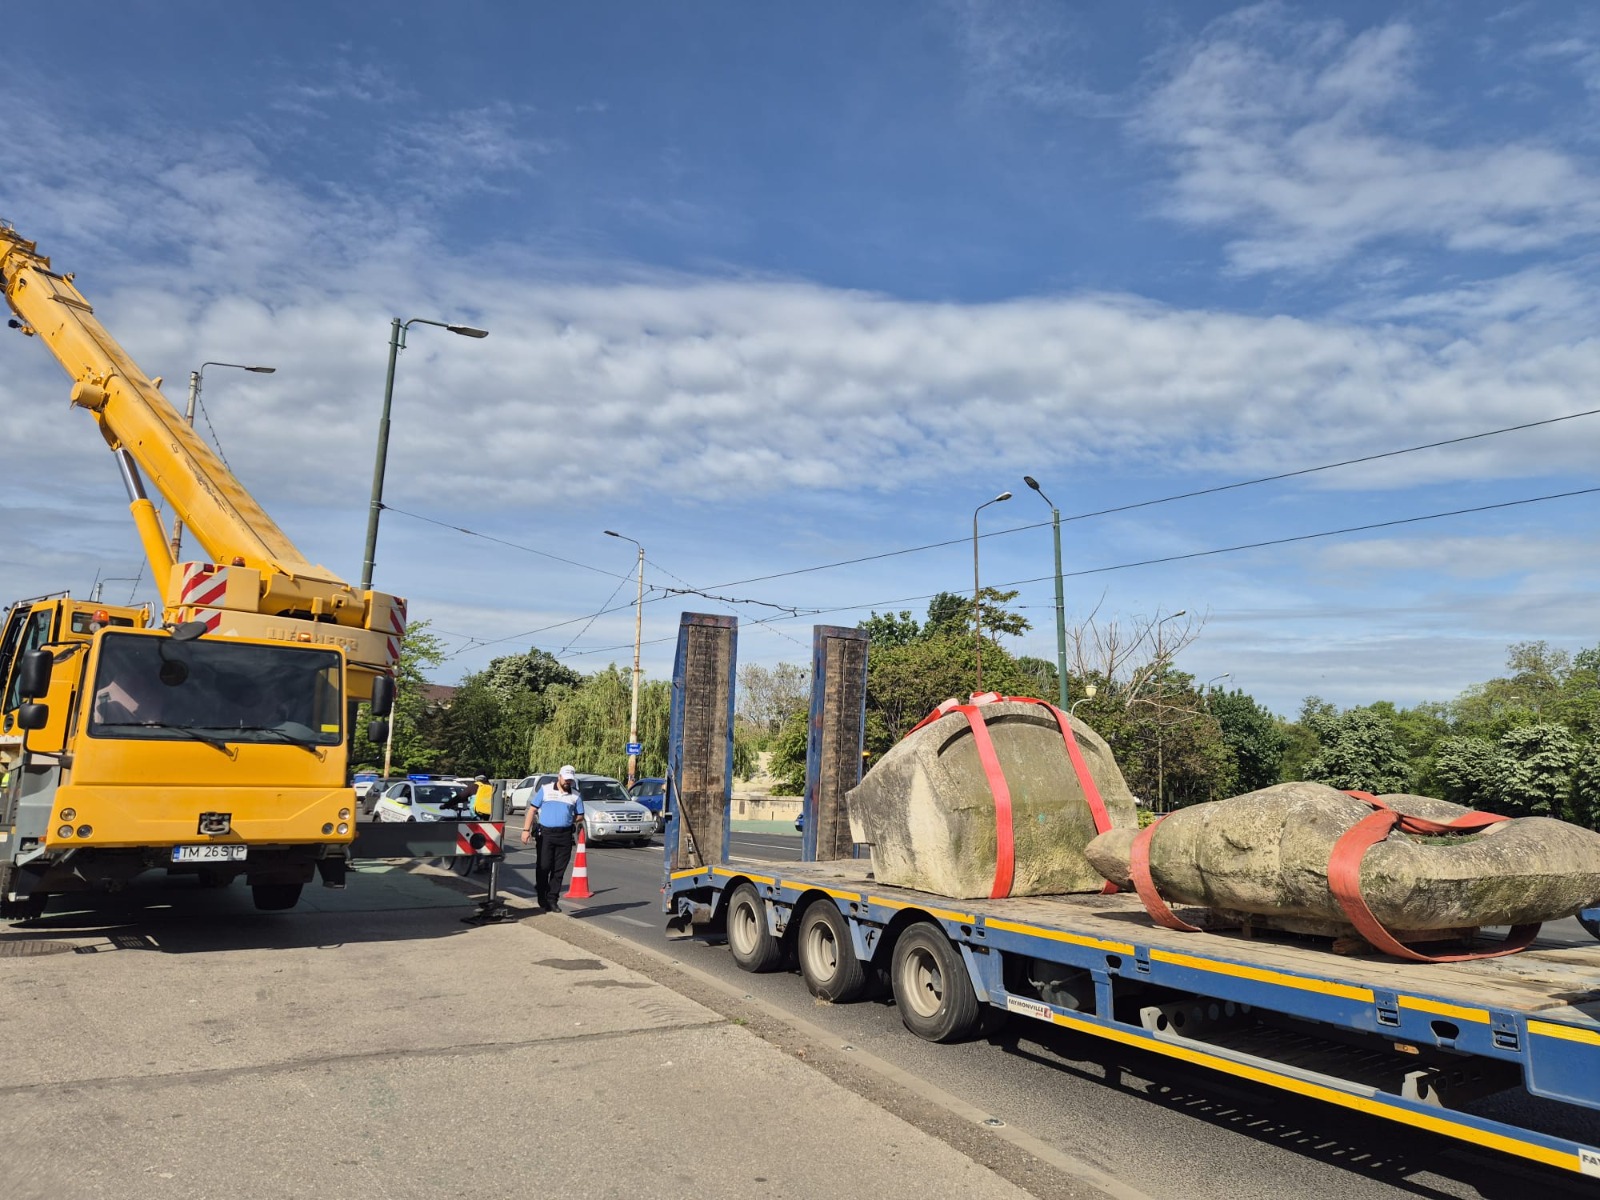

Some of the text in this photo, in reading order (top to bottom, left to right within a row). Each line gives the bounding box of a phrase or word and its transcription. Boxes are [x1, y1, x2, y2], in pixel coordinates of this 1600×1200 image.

[267, 627, 358, 652] LIEHERR
[182, 847, 200, 858] TM
[1008, 999, 1044, 1012] FAYMONVILLE
